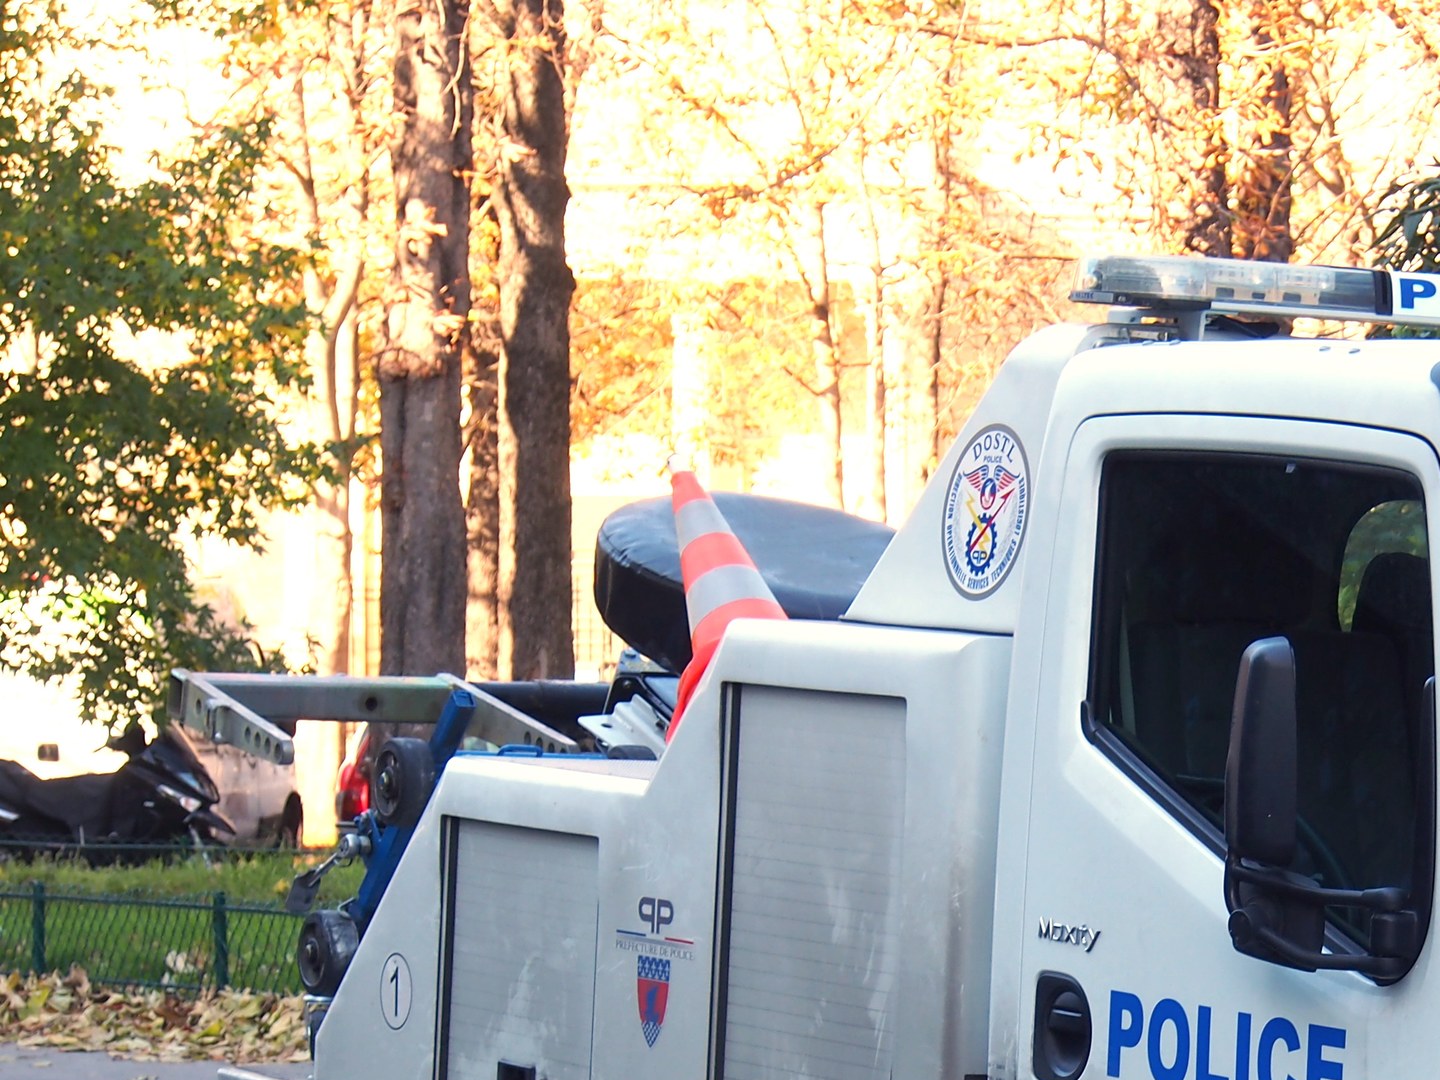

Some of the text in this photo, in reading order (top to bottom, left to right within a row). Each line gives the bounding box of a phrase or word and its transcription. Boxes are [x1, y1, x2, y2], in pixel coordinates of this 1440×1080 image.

[973, 432, 1015, 463] DOSTL
[983, 455, 1003, 463] POLICE
[1038, 915, 1102, 953] Maxity
[659, 947, 669, 956] DE
[669, 947, 695, 961] POLICE
[390, 966, 399, 1017] 1
